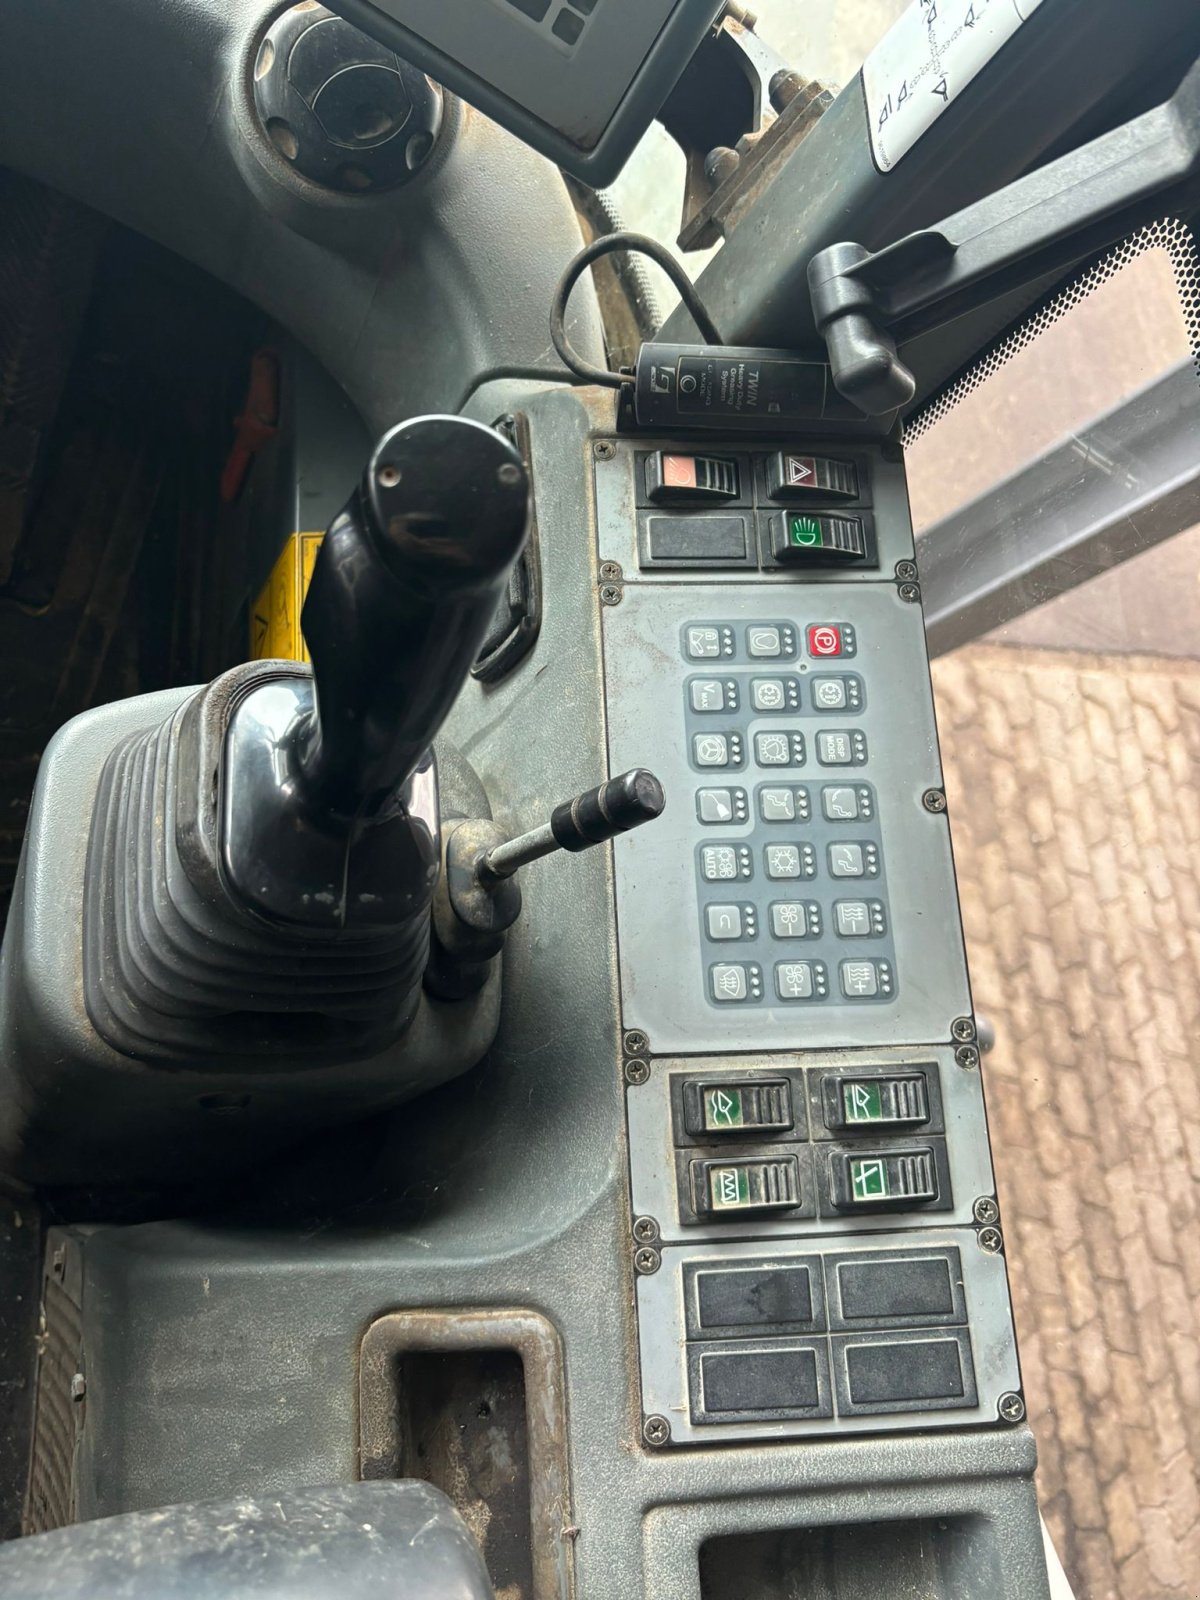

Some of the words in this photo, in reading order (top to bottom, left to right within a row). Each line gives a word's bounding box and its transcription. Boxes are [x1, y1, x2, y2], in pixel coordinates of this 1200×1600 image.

[720, 370, 729, 401] System
[727, 367, 737, 405] Greasing
[736, 363, 745, 390] Heavy
[746, 370, 760, 406] TWIN
[734, 391, 743, 411] Duty
[826, 735, 836, 760] MODE
[836, 737, 845, 757] DISP
[704, 849, 717, 878] AUTO
